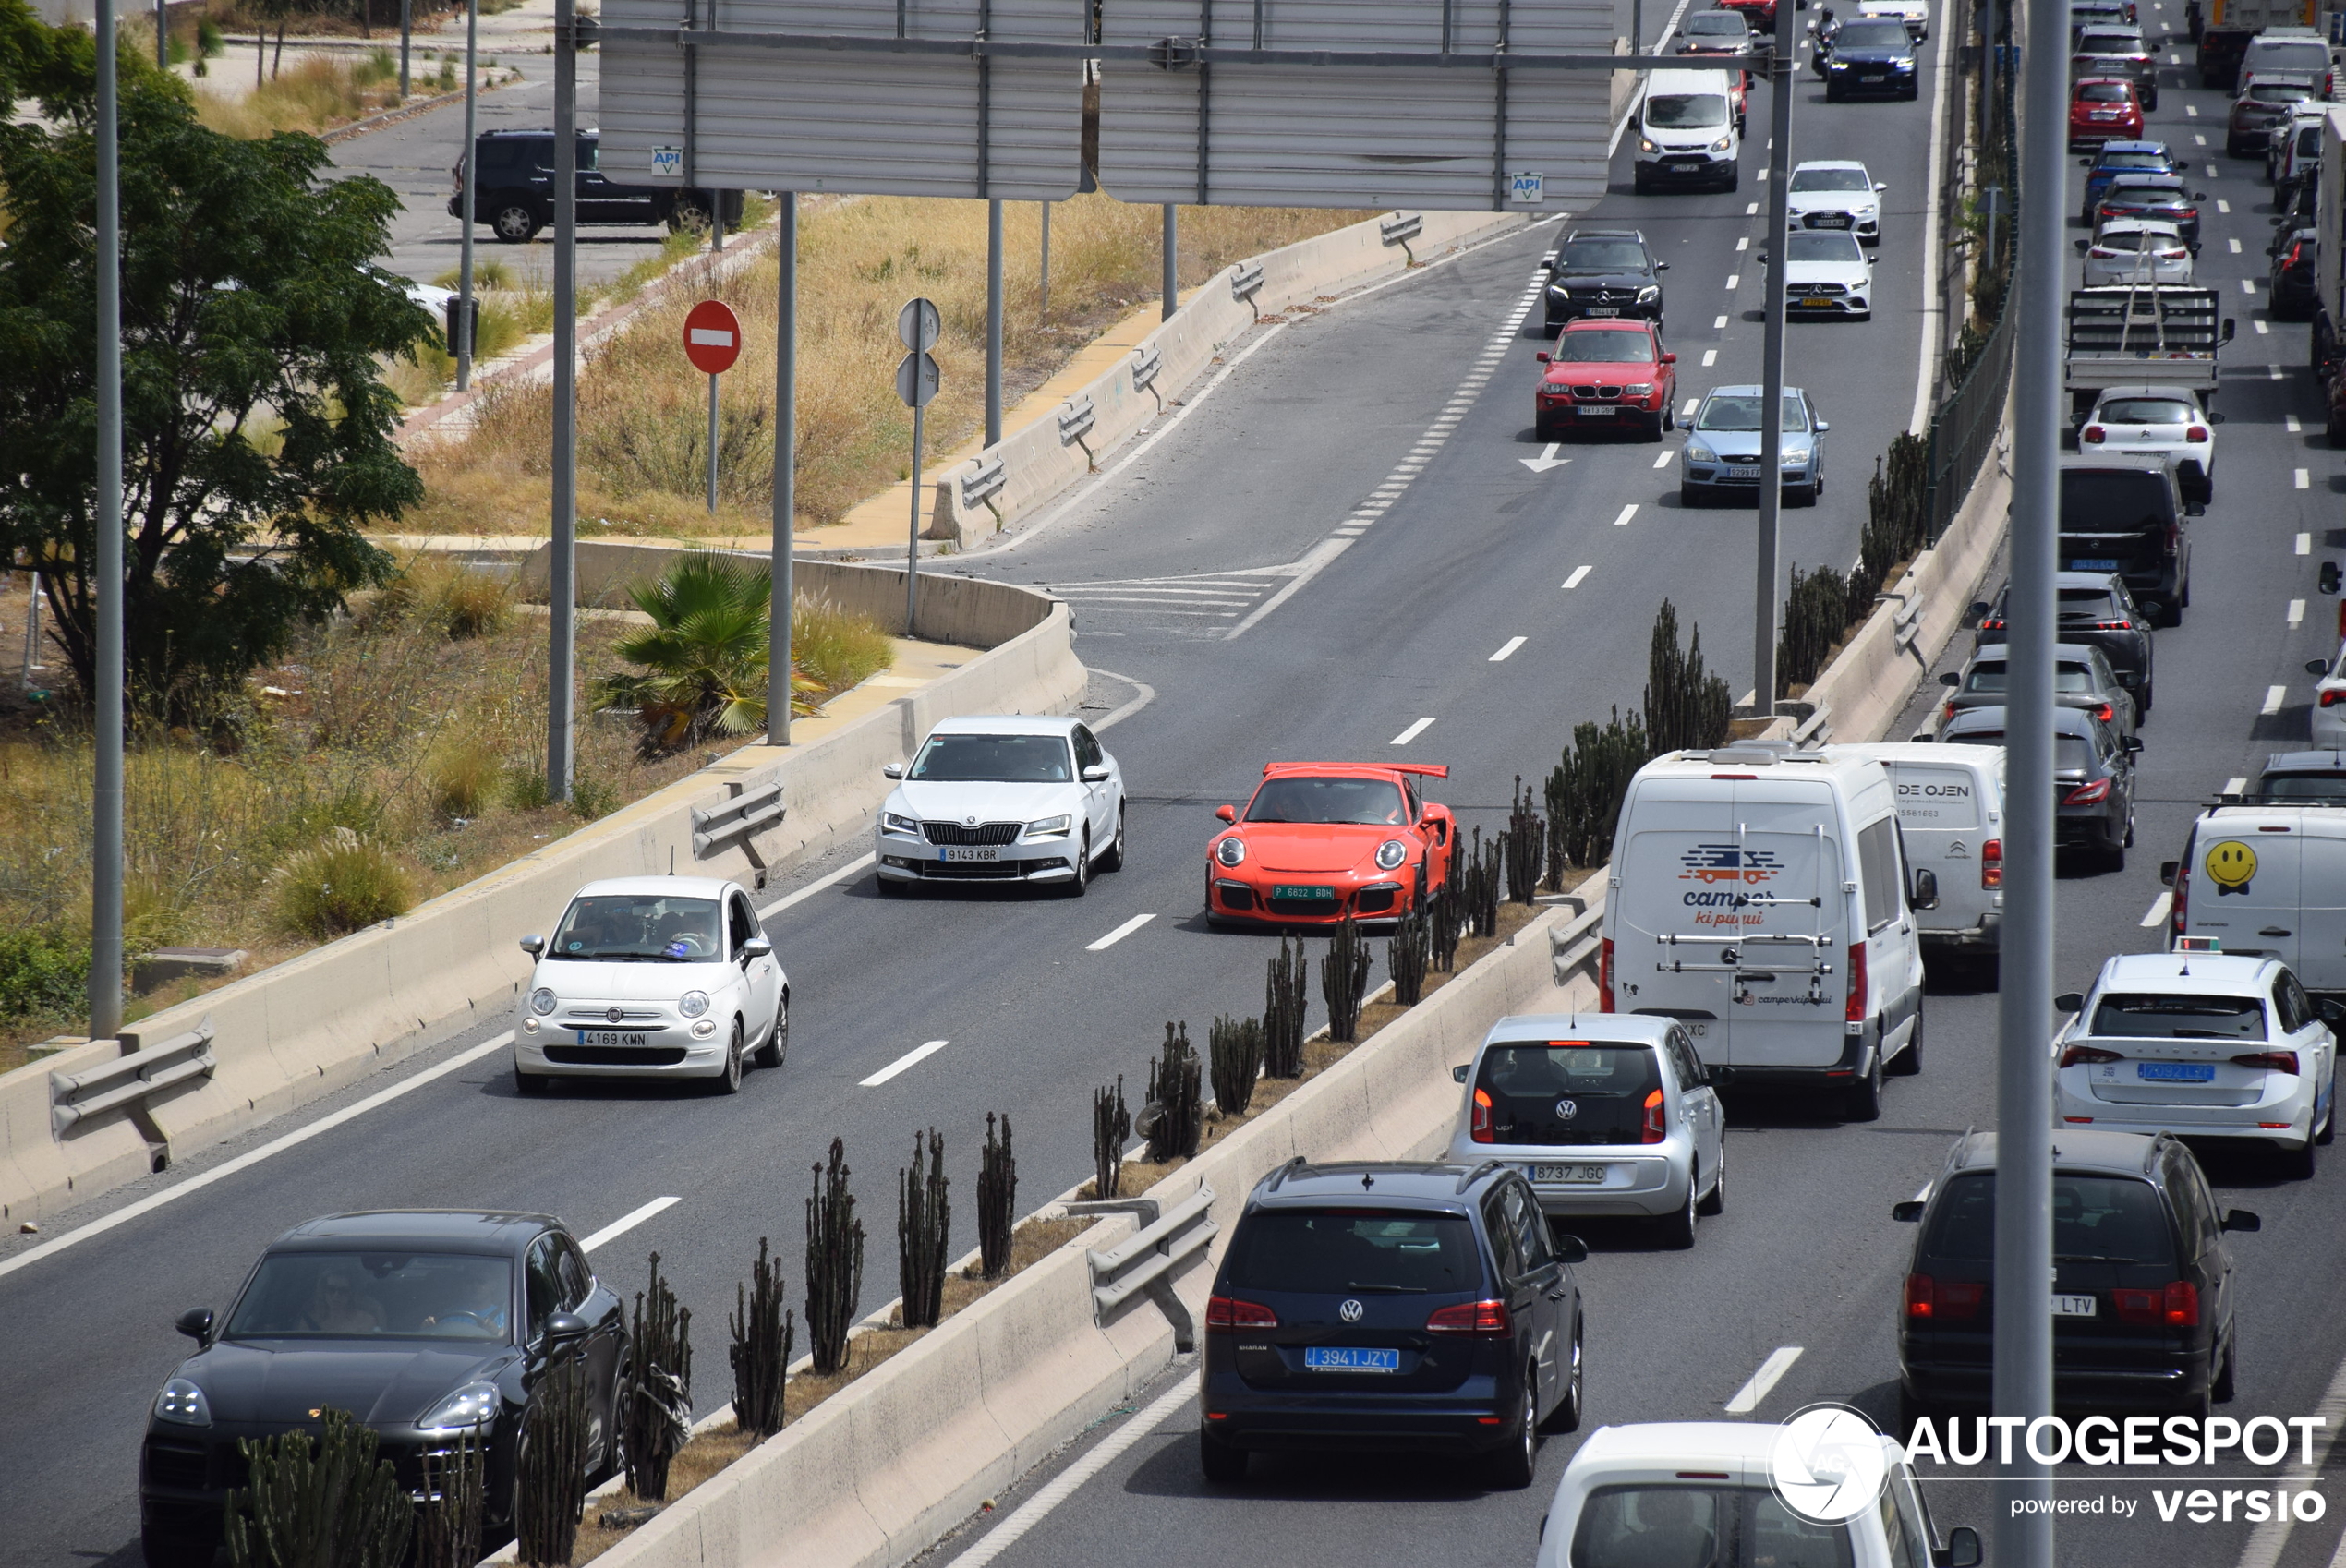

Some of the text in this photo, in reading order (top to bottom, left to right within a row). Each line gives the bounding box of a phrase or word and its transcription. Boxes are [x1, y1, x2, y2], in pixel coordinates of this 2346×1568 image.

[653, 153, 681, 164] API
[1512, 179, 1540, 190] API
[1731, 468, 1750, 476] 9299
[1898, 784, 1969, 797] DE OJEN
[949, 850, 997, 861] 9143 KBR
[1276, 887, 1282, 897] P
[1288, 887, 1308, 898] 6622
[1683, 890, 1777, 912] camper
[586, 1031, 646, 1046] 4169 KMN
[2146, 1064, 2181, 1078] 7092
[1537, 1166, 1604, 1180] 8737 JGC
[2062, 1297, 2092, 1313] LTV
[1321, 1349, 1391, 1367] 3941 JZY
